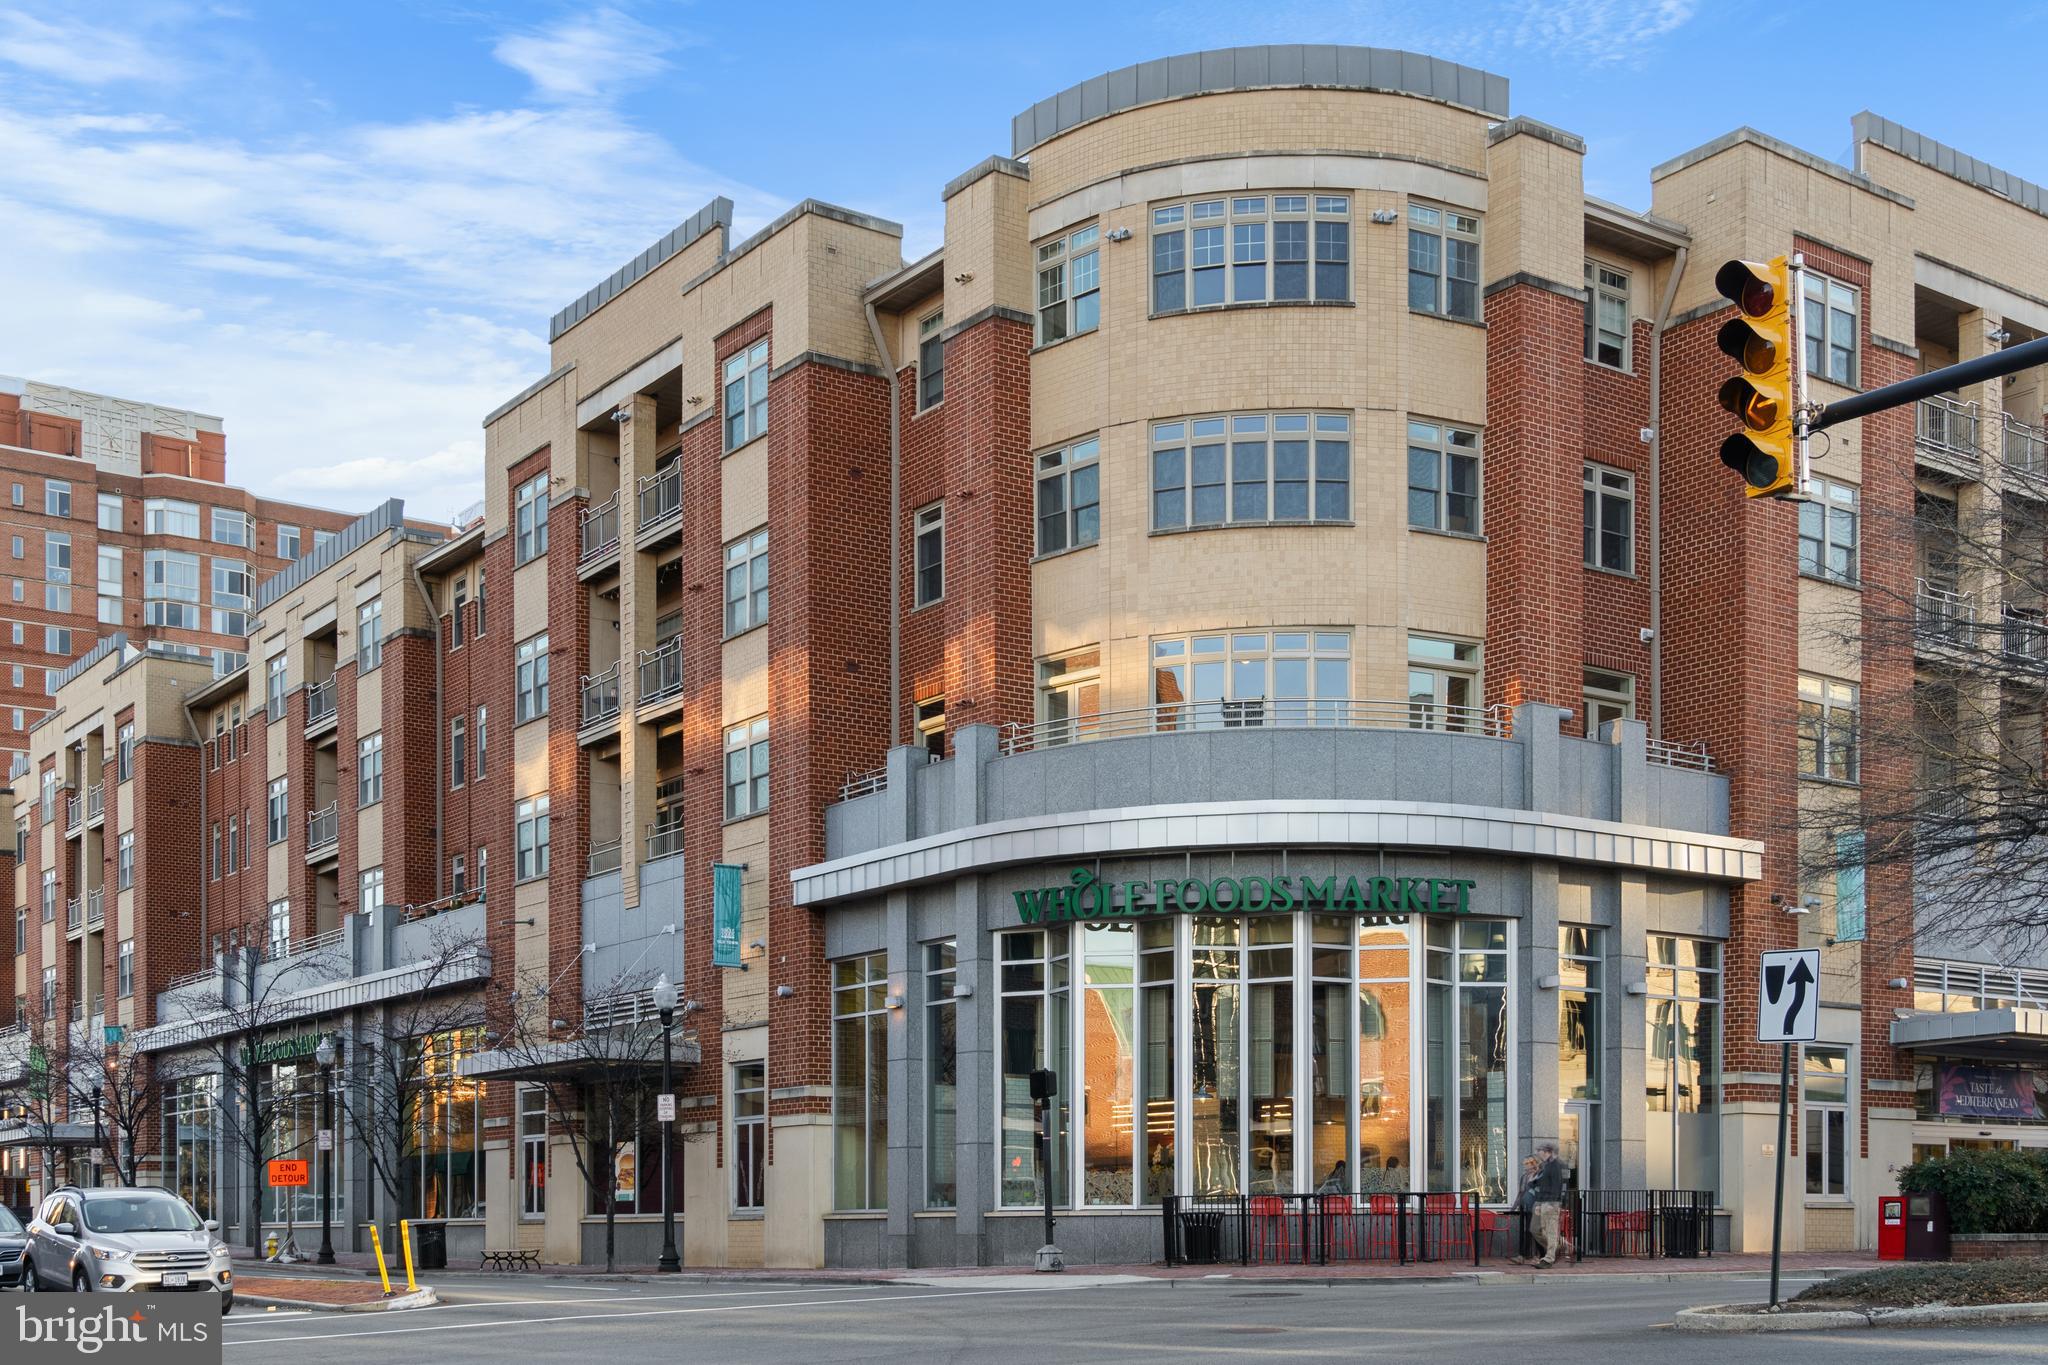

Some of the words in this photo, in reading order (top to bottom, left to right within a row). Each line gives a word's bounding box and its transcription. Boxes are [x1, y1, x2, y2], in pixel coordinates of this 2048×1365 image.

[1012, 867, 1148, 924] WHOLE
[1154, 876, 1294, 914] FOODS
[1300, 875, 1477, 914] MARKET
[267, 1037, 297, 1062] FOODS
[1970, 1082, 1994, 1094] TASTE
[1995, 1086, 2004, 1095] the
[1955, 1095, 2019, 1110] MEDITERRANEAN
[280, 1163, 297, 1171] END
[272, 1174, 305, 1182] DETOUR
